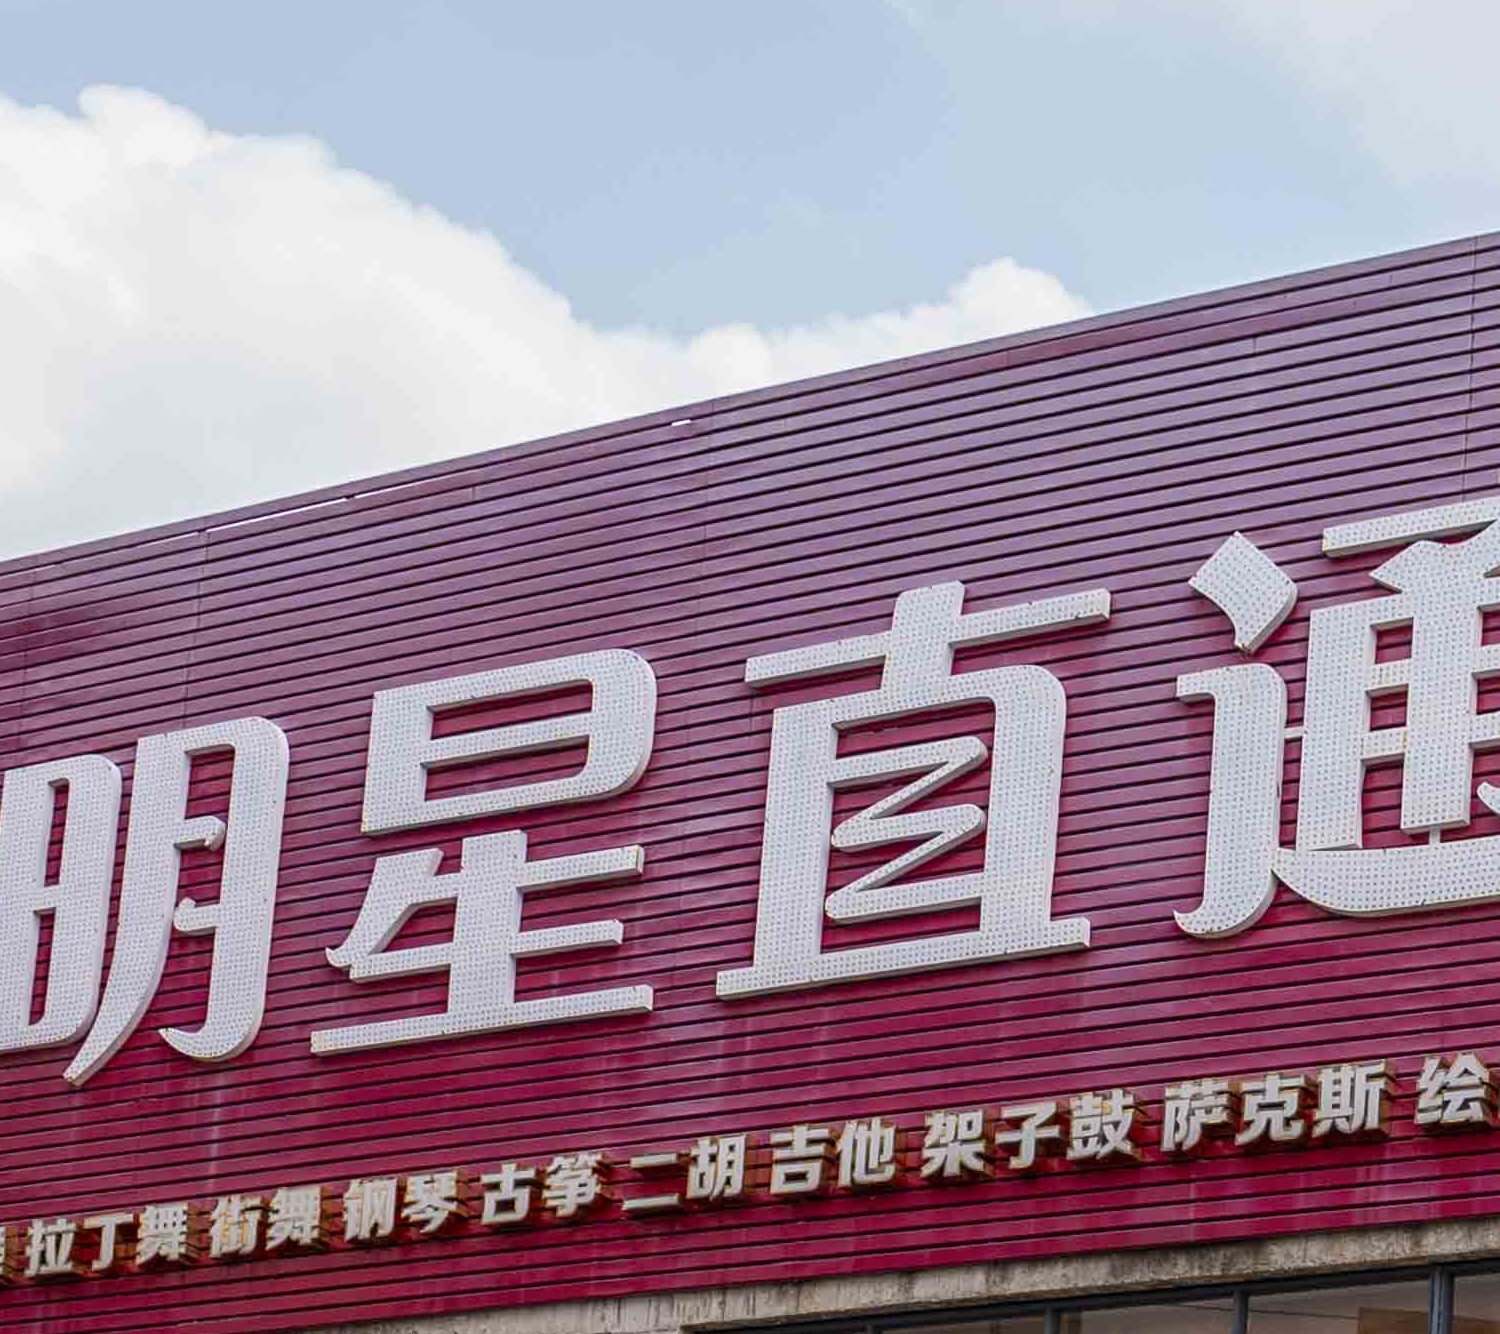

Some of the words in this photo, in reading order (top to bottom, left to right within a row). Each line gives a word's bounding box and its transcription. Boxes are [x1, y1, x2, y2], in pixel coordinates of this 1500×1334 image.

[24, 1201, 190, 1278] 拉丁舞
[209, 1185, 322, 1258] 街舞
[342, 1170, 460, 1240] 钢琴
[480, 1153, 602, 1225] 古筝
[622, 1133, 748, 1213] 二胡
[769, 1117, 897, 1195] 吉他
[1162, 1059, 1387, 1151] 萨克斯
